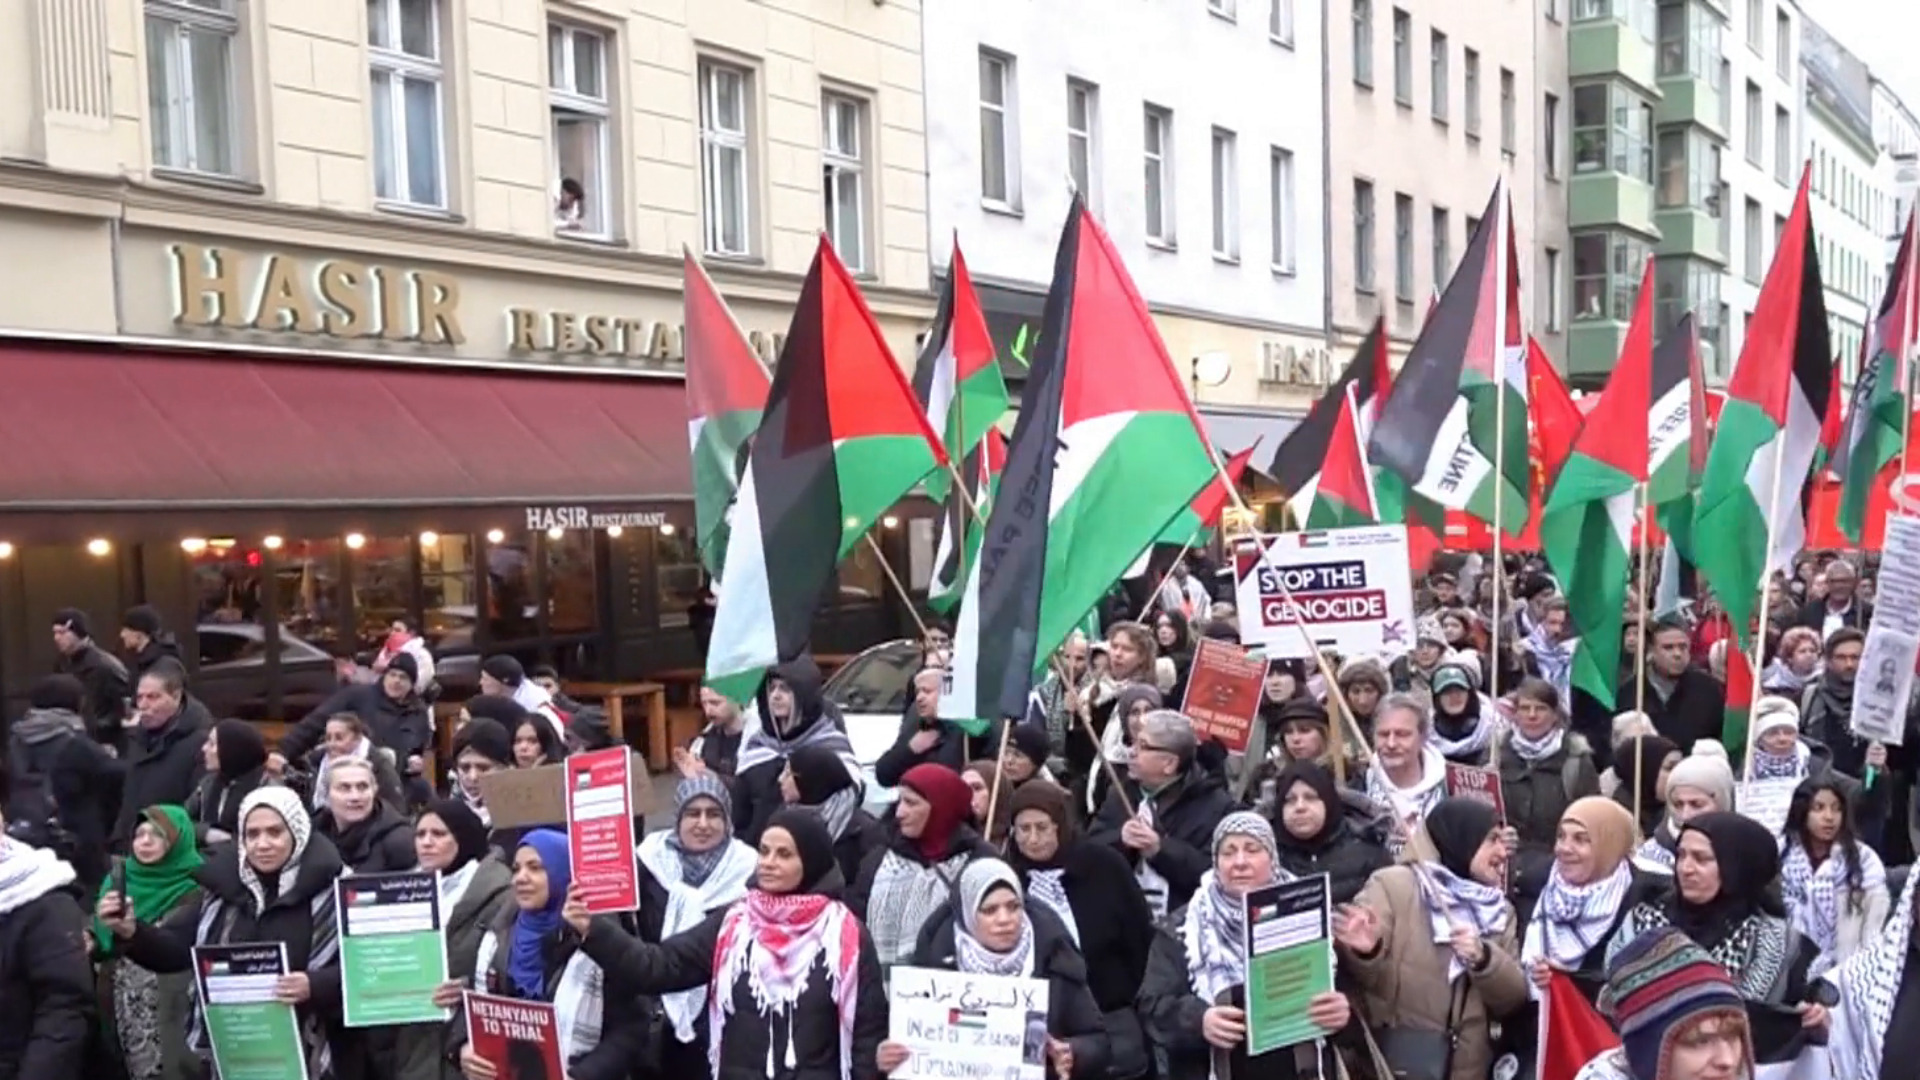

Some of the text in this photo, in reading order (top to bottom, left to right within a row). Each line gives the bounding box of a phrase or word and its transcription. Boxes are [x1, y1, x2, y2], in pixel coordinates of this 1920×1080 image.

[168, 243, 466, 345] HASIR
[526, 506, 665, 530] HASIR RESTAURANT
[1319, 564, 1363, 588] THE
[1265, 594, 1384, 622] GENOCIDE
[1454, 767, 1488, 788] STOP
[471, 999, 549, 1026] NETANYAHU
[482, 1017, 545, 1042] TO TRIAL
